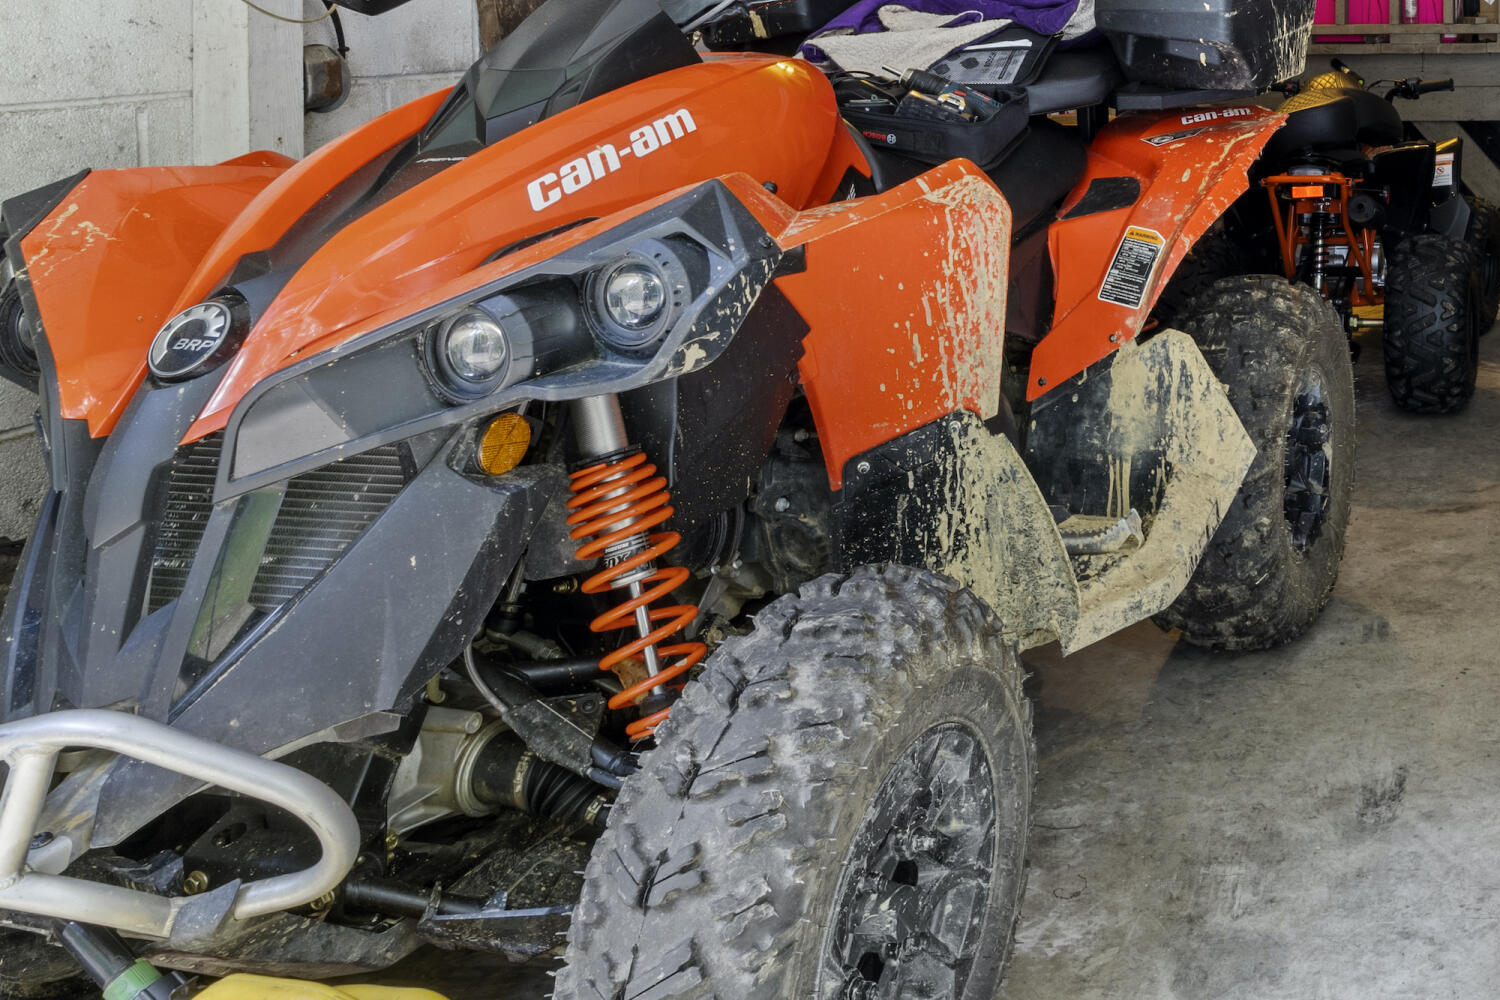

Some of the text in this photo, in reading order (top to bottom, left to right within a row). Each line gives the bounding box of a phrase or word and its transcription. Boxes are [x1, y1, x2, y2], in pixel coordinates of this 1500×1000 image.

[1181, 107, 1252, 125] can-am
[527, 108, 697, 212] can-am
[172, 338, 216, 352] BRP
